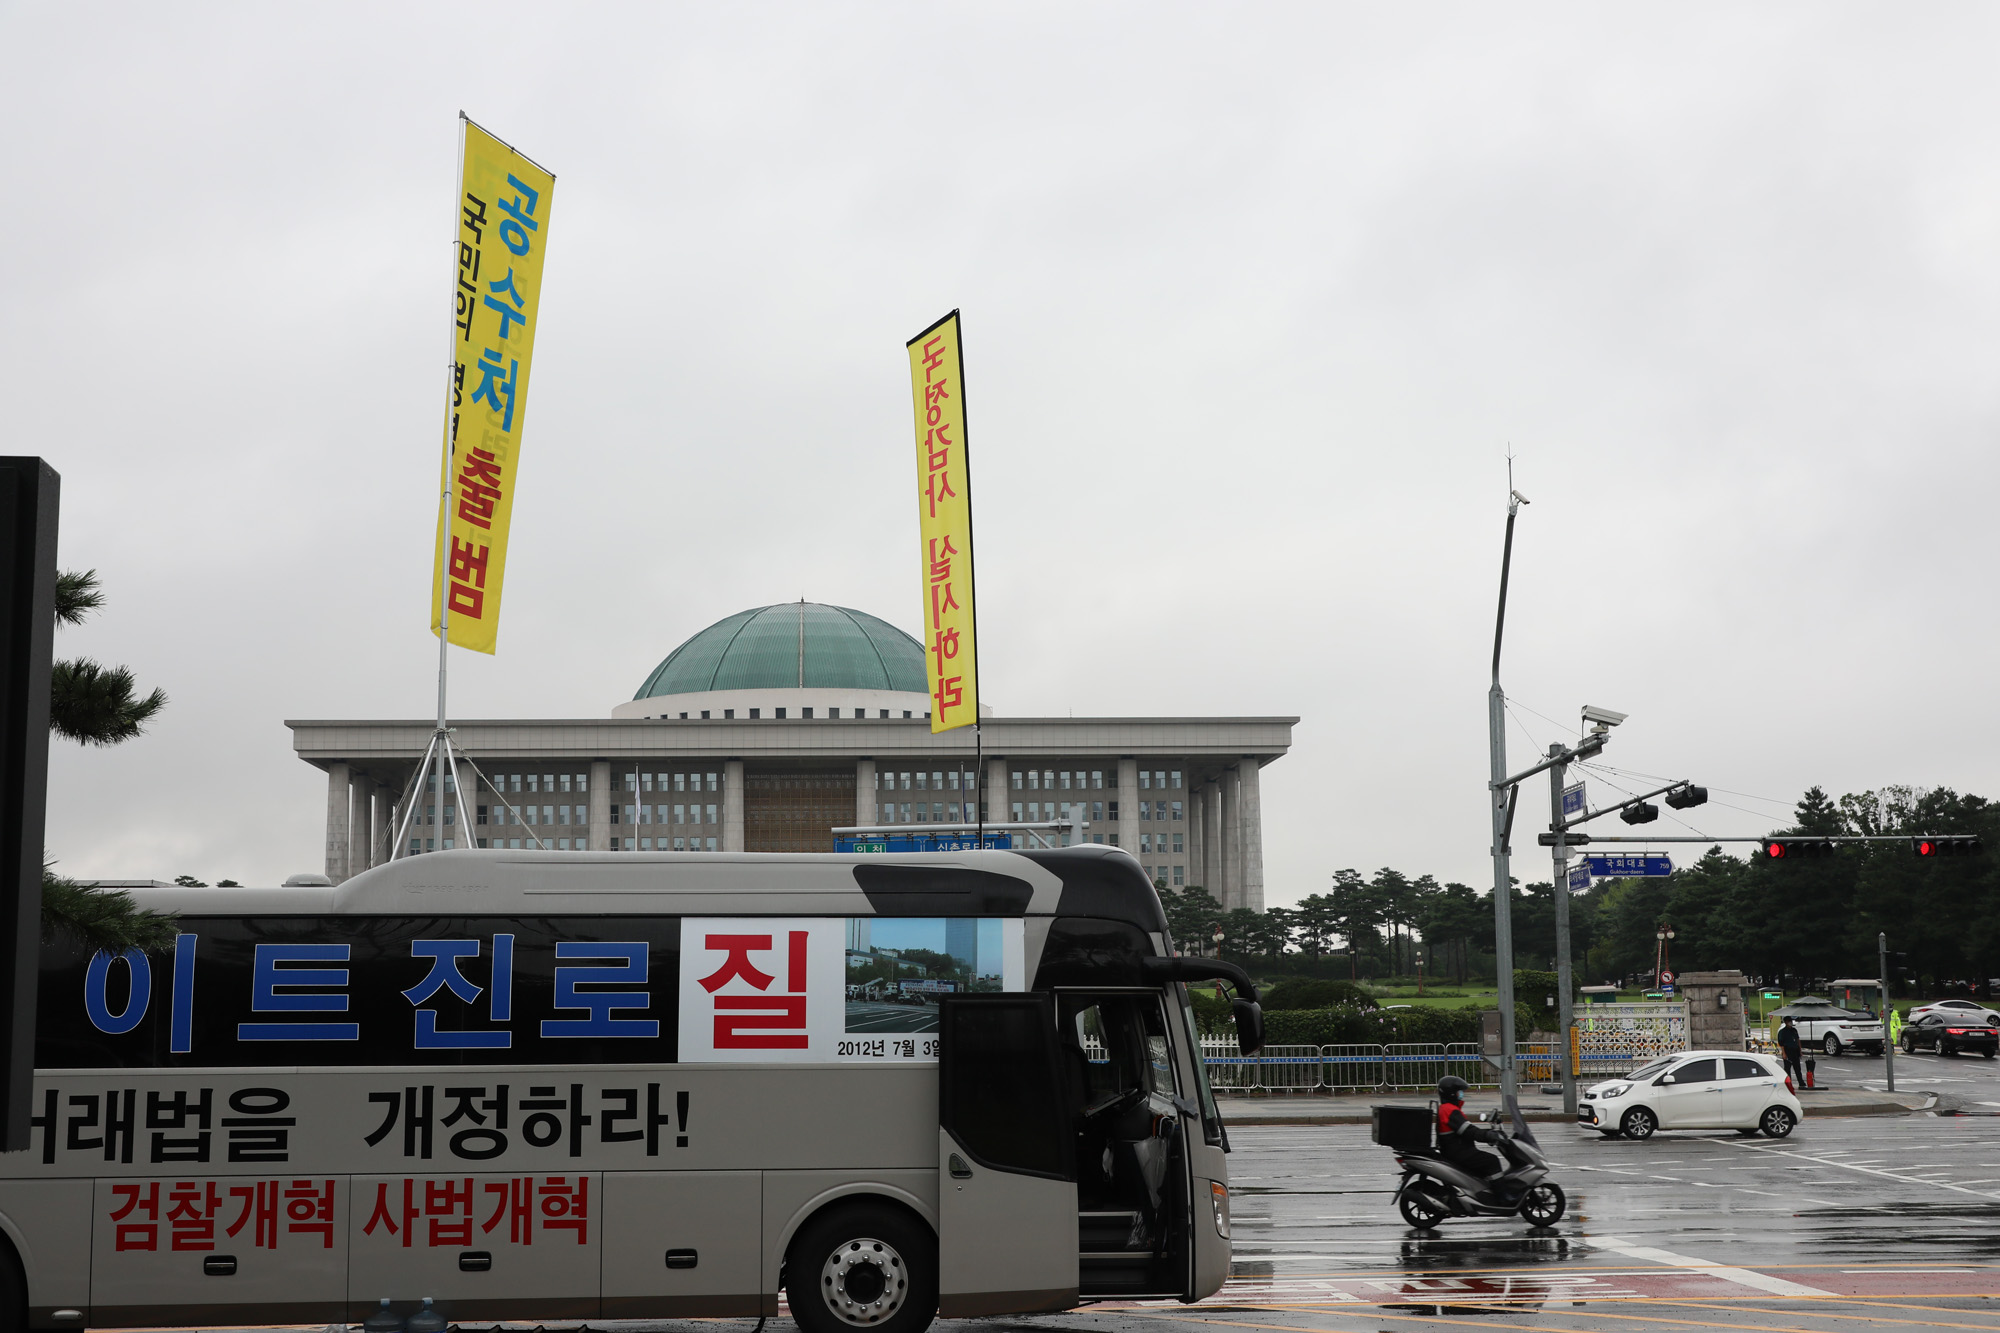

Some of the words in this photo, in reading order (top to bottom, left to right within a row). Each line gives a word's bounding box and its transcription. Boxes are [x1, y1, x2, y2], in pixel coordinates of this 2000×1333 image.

[455, 192, 487, 341] 국민의
[471, 172, 538, 432] 공수처
[447, 446, 502, 620] 출범
[1605, 858, 1646, 868] 국회대로
[697, 930, 810, 1050] 질
[837, 1039, 885, 1057] 2012년
[893, 1039, 915, 1057] 7월
[364, 1083, 690, 1161] 개정하라!
[109, 1179, 335, 1252] 검찰개혁
[363, 1176, 590, 1248] 사법개혁
